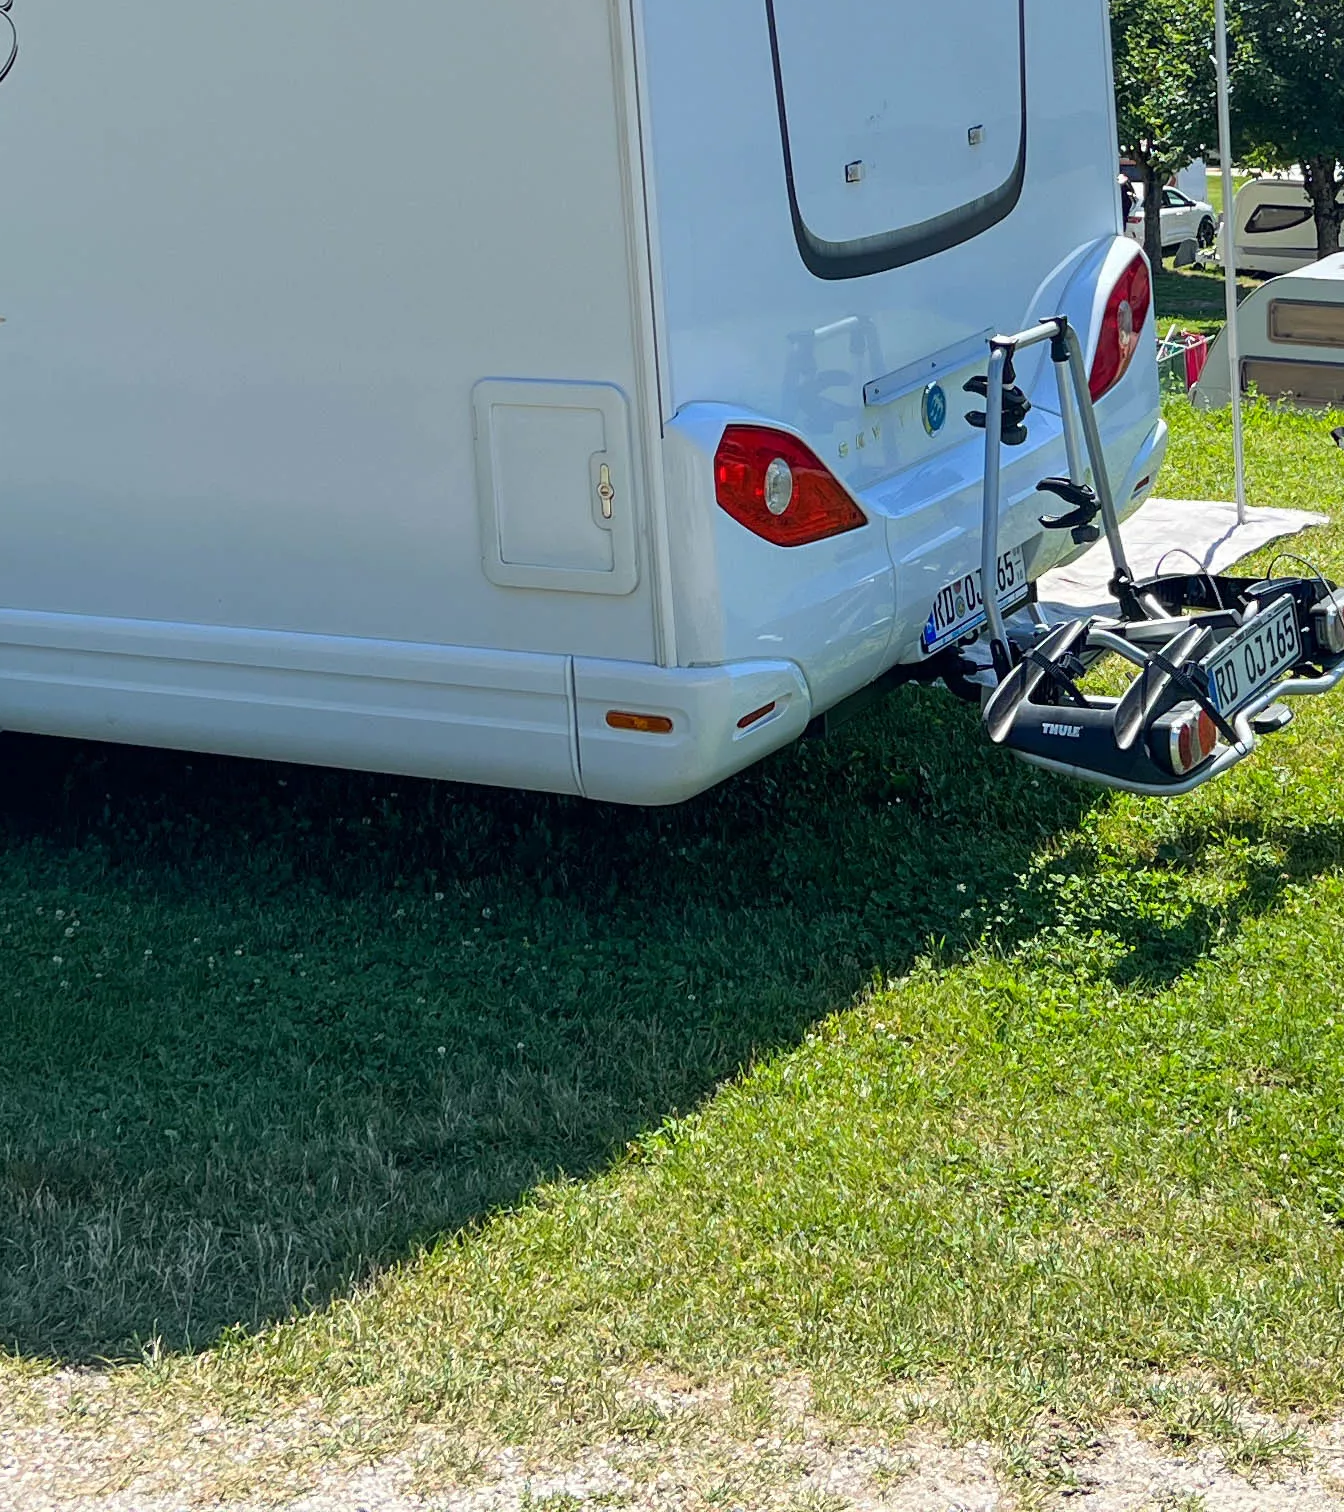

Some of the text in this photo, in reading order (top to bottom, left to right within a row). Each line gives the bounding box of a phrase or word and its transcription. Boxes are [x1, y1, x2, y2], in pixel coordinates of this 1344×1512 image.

[933, 586, 955, 631] RD
[1215, 659, 1238, 710] RD
[1042, 722, 1081, 738] THULE
